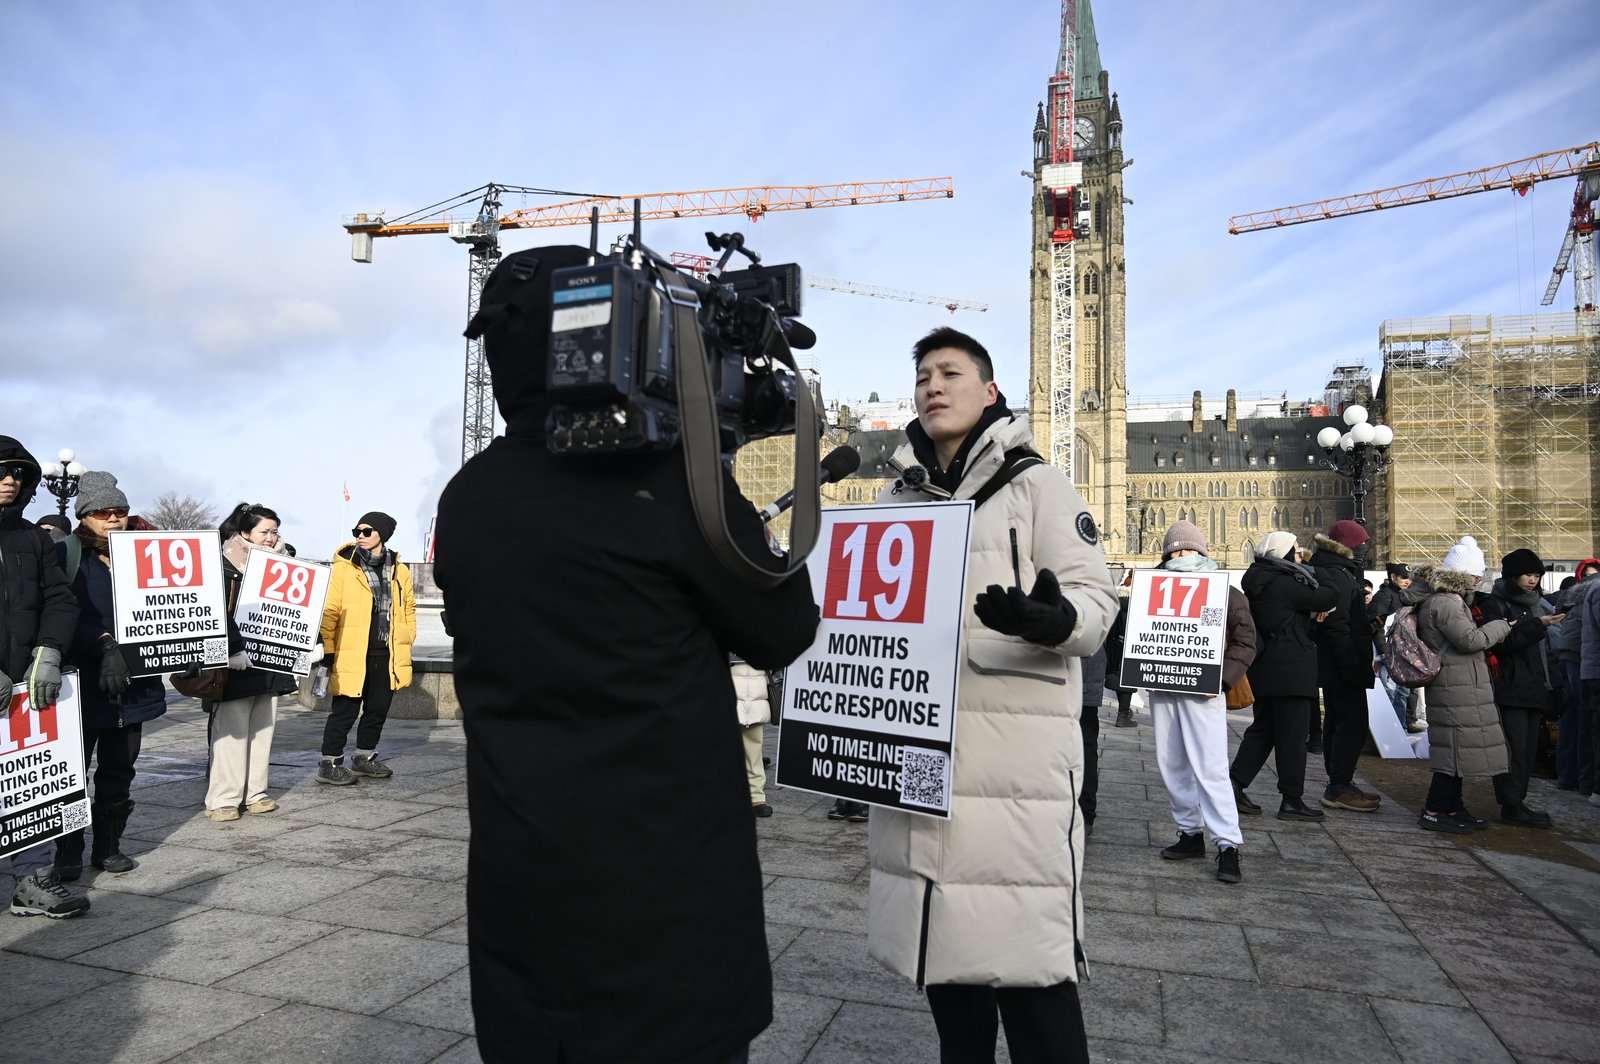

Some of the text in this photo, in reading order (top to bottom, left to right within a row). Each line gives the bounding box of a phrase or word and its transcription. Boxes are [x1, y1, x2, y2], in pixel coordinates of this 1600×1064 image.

[568, 276, 598, 287] SONY
[144, 539, 193, 587] 19
[835, 522, 915, 621] 19
[264, 561, 310, 605] 28
[145, 592, 198, 606] MONTHS
[1156, 577, 1200, 617] 17
[132, 606, 212, 622] WAITING FOR
[260, 602, 301, 619] MONTHS
[125, 619, 219, 637] IRCC RESPONSE
[248, 612, 309, 632] WAITING FOR
[1151, 621, 1198, 633] MONTHS
[239, 622, 311, 645] IRCC RESPONSE
[1139, 633, 1210, 646] WAITING FOR
[139, 645, 155, 657] NO
[245, 641, 299, 659] NO TIMELINES
[827, 633, 909, 660] MONTHS
[1131, 644, 1216, 660] IRCC RESPONSE
[144, 652, 205, 668] NO RESULTS
[247, 651, 294, 667] NO RESULTS
[806, 660, 930, 694] WAITING FOR
[1139, 662, 1202, 676] NO TIMELINES
[1142, 673, 1198, 686] NO RESULTS
[793, 688, 940, 728] IRCC RESPONSE
[807, 732, 904, 766] NO TIMELINE
[0, 761, 68, 793] ITING FOR
[811, 757, 904, 792] NO RESULTS
[4, 774, 77, 809] RESPONSE
[0, 835, 10, 848] O
[12, 816, 62, 843] RESULTS
